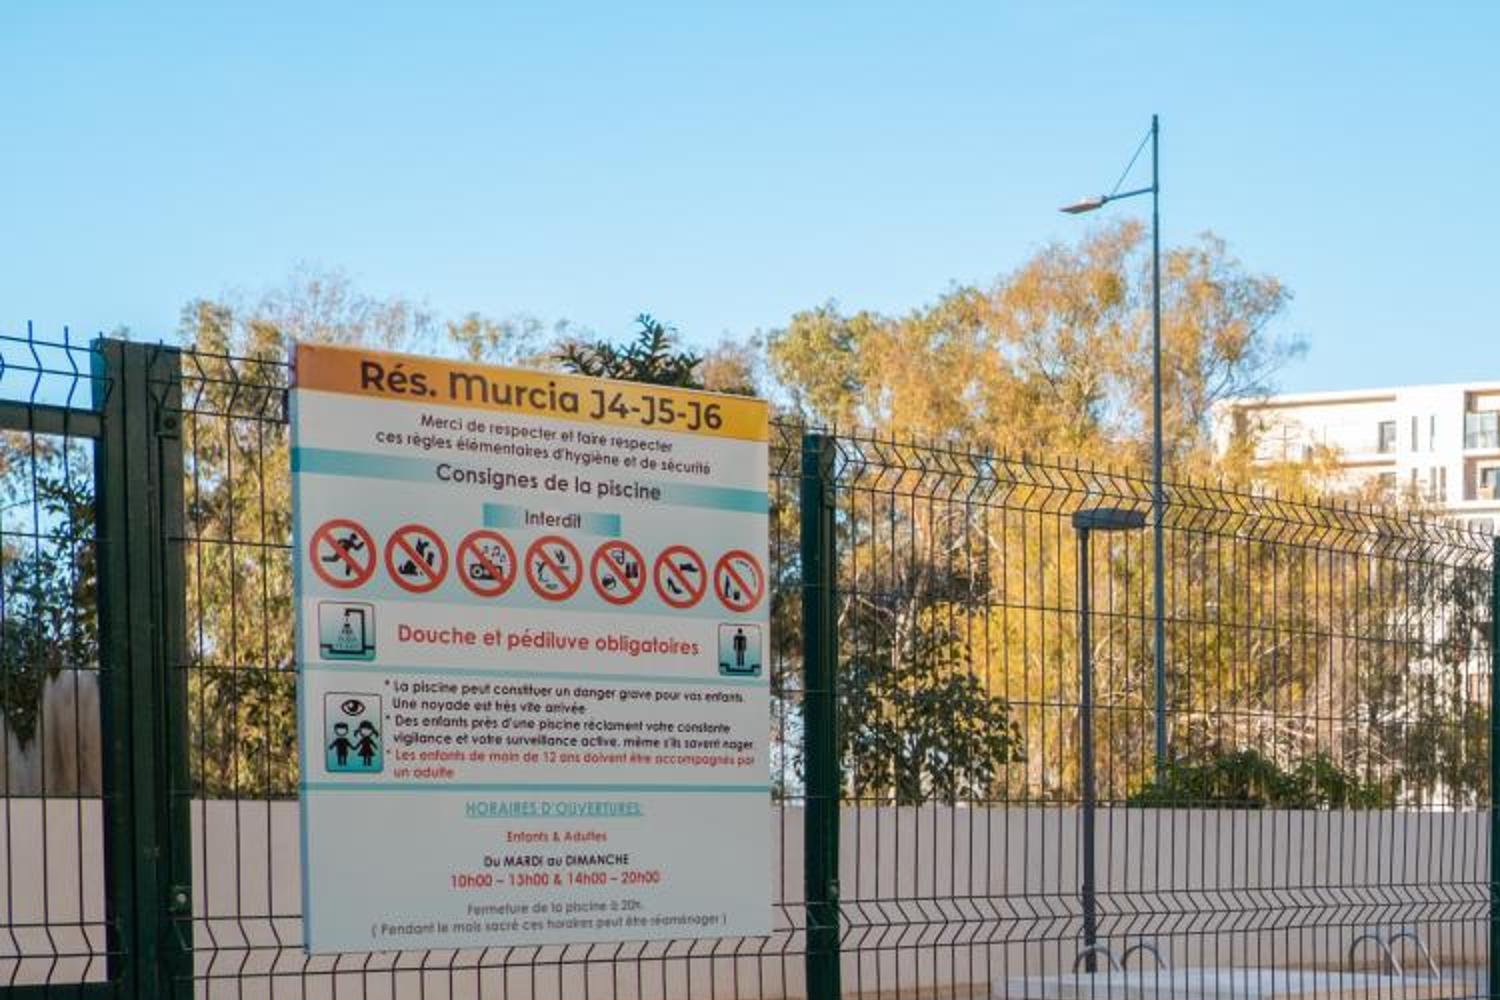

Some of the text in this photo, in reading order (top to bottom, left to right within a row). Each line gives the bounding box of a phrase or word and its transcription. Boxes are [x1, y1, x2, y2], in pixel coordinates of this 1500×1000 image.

[360, 361, 437, 397] Rés.
[590, 390, 722, 431] J4-J5-J6
[421, 414, 673, 452] Merci de respecter et faire respecter
[375, 431, 402, 444] ces
[407, 432, 453, 450] règles
[456, 436, 549, 459] élémentaires
[623, 455, 636, 467] et
[640, 457, 657, 469] de
[661, 460, 711, 475] sécurité
[436, 463, 662, 501] Consignes de la piscine
[524, 511, 582, 530] Interdit
[398, 624, 700, 657] Douche et pédiluve obligatoires
[394, 681, 409, 692] La
[413, 682, 458, 695] piscine
[461, 683, 491, 696] peut
[493, 684, 553, 697] constituer
[555, 687, 571, 697] un
[573, 687, 616, 700] danger
[619, 690, 652, 701] grave
[655, 690, 681, 701] pour
[684, 692, 701, 701] vos
[392, 698, 417, 709] Une
[421, 700, 470, 711] noyade
[473, 701, 492, 711] est
[519, 701, 541, 712] vite
[395, 714, 731, 734] Des enfants près d'une piscine réclament votre constante
[393, 732, 452, 747] vigilance
[456, 732, 469, 744] et
[471, 734, 504, 745] votre
[507, 733, 578, 746] surveillance
[395, 749, 417, 761] Les
[420, 750, 465, 762] enfants
[469, 750, 485, 762] de
[523, 751, 539, 763] de
[544, 751, 557, 763] 12
[560, 752, 581, 764] ans
[583, 752, 627, 764] doivent
[393, 765, 454, 778] un adulte
[465, 801, 536, 817] HORAIRES
[506, 831, 548, 843] Enfants
[564, 831, 607, 843] Adultes
[483, 853, 629, 868] Du MARDI au DIMANCHE
[450, 874, 493, 888] 10h00
[567, 871, 607, 885] 14h00
[621, 870, 660, 884] 20h00
[467, 902, 529, 915] Fermeture
[532, 902, 548, 913] de
[552, 902, 563, 913] la
[566, 901, 607, 913] piscine
[381, 923, 434, 936] Pendant
[437, 922, 448, 934] le
[453, 920, 481, 933] mois
[485, 918, 519, 931] sacré
[522, 920, 544, 931] ces
[547, 918, 593, 930] horaires
[595, 916, 623, 929] peut
